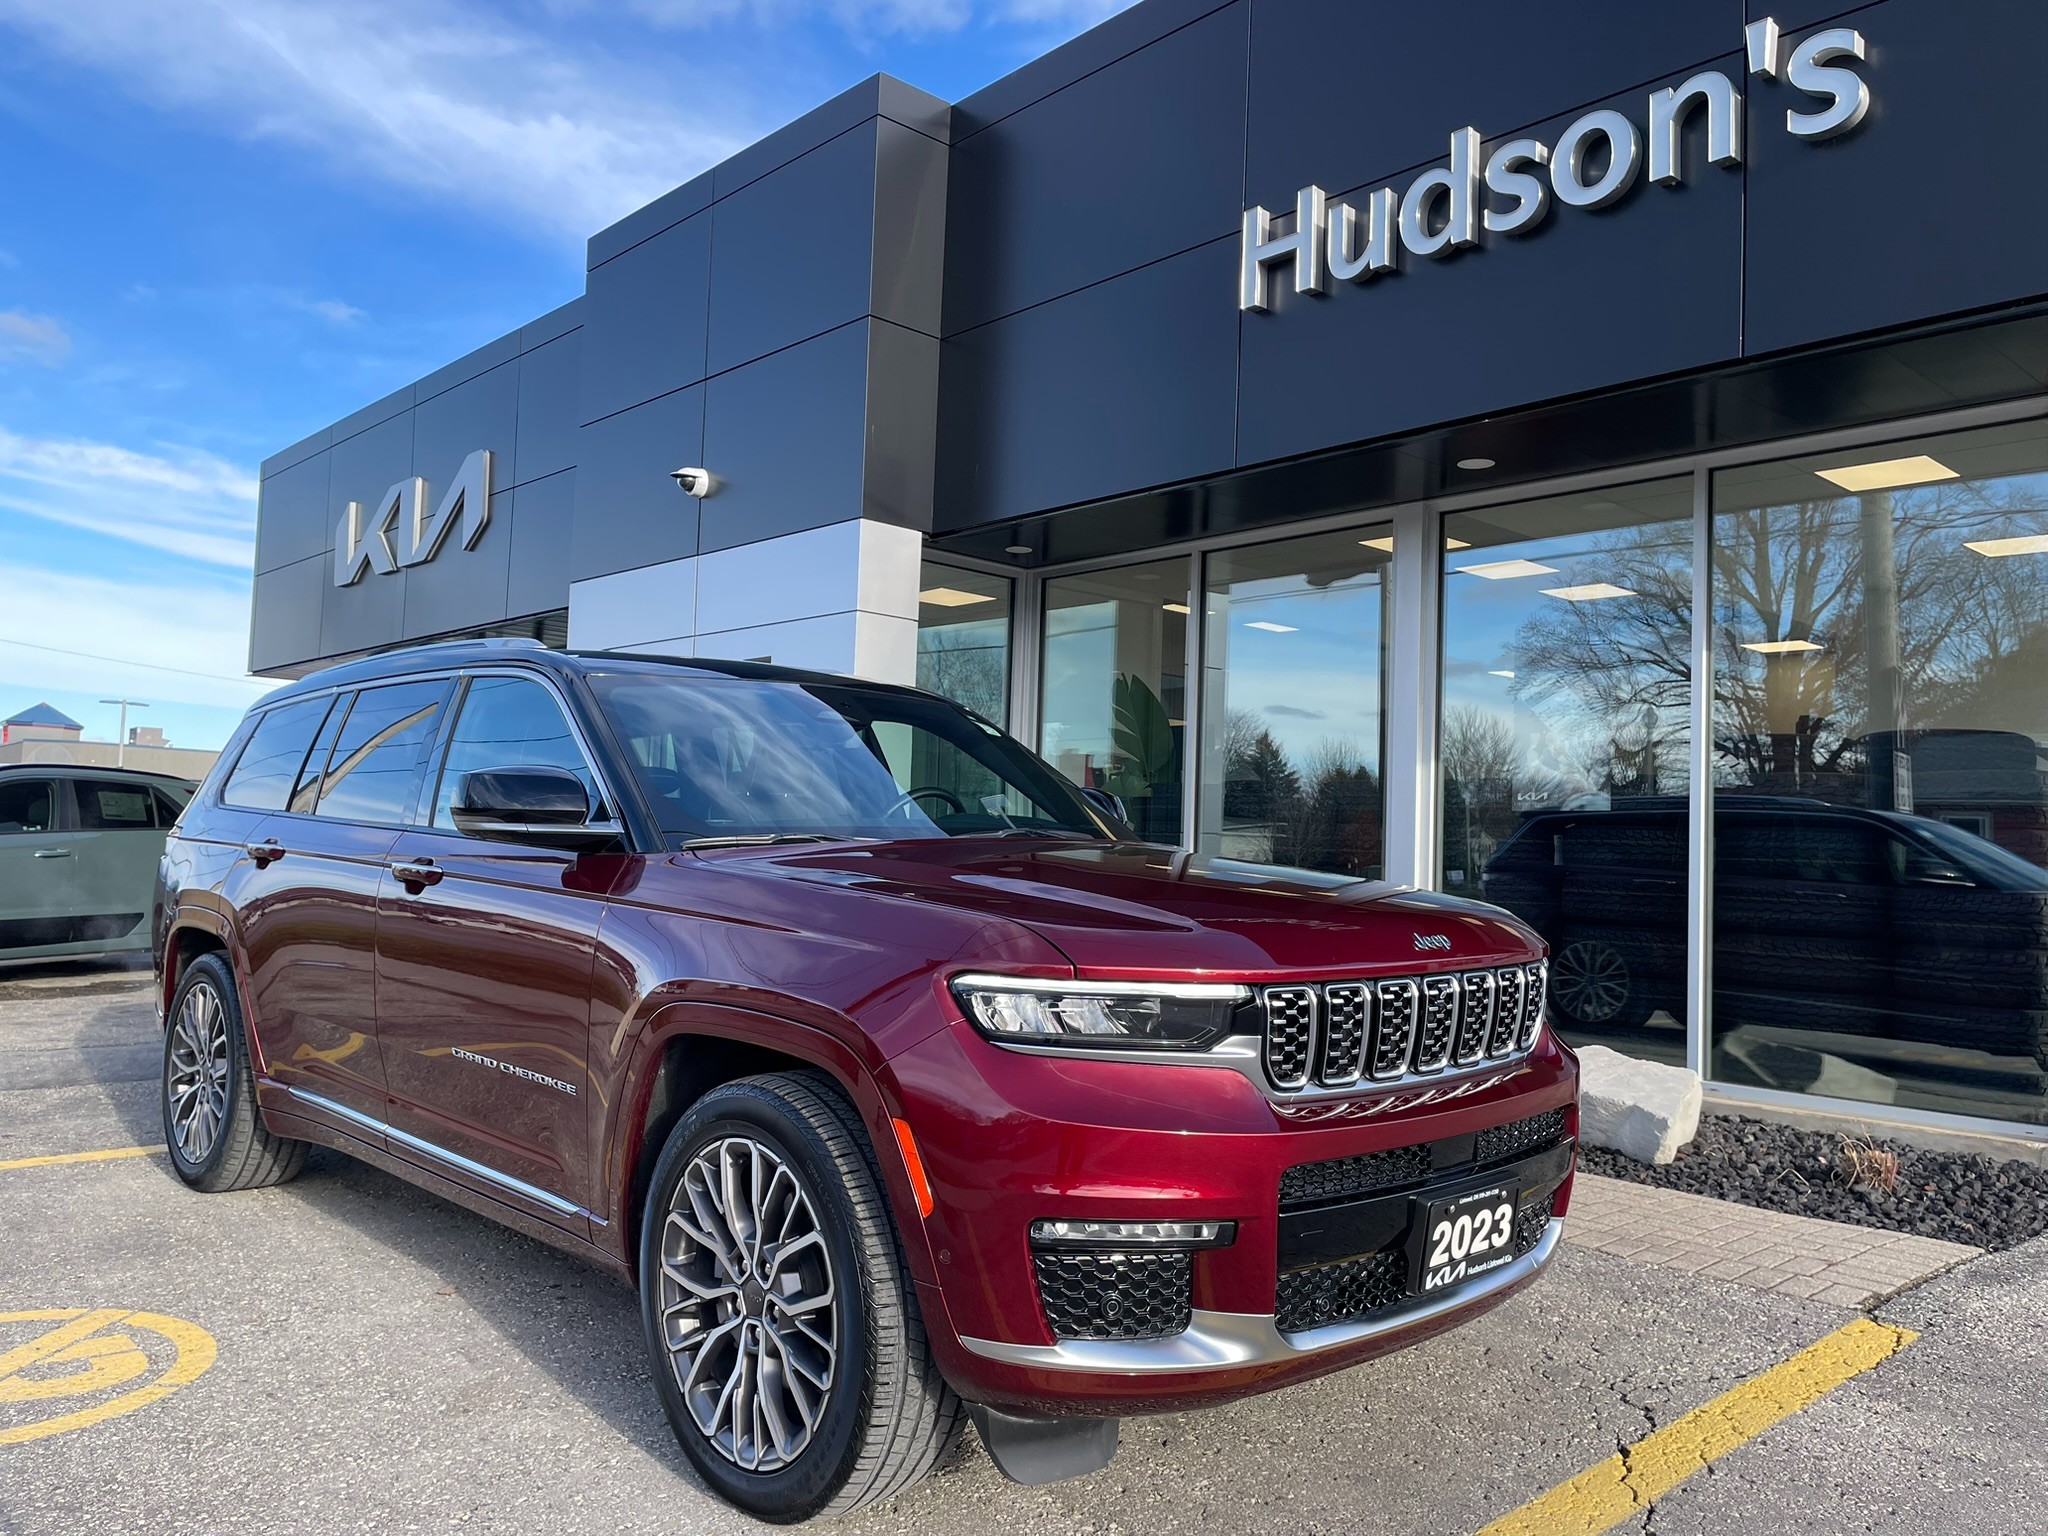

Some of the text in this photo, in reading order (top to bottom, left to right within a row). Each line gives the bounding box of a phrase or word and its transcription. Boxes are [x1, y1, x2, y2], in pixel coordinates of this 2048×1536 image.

[1240, 16, 1869, 313] Hudson's
[333, 448, 491, 587] KIA
[1413, 932, 1451, 952] Jeep
[451, 1047, 577, 1096] GRAND CHEROKEE
[1429, 1204, 1512, 1267] 2023
[1425, 1261, 1467, 1290] KIA
